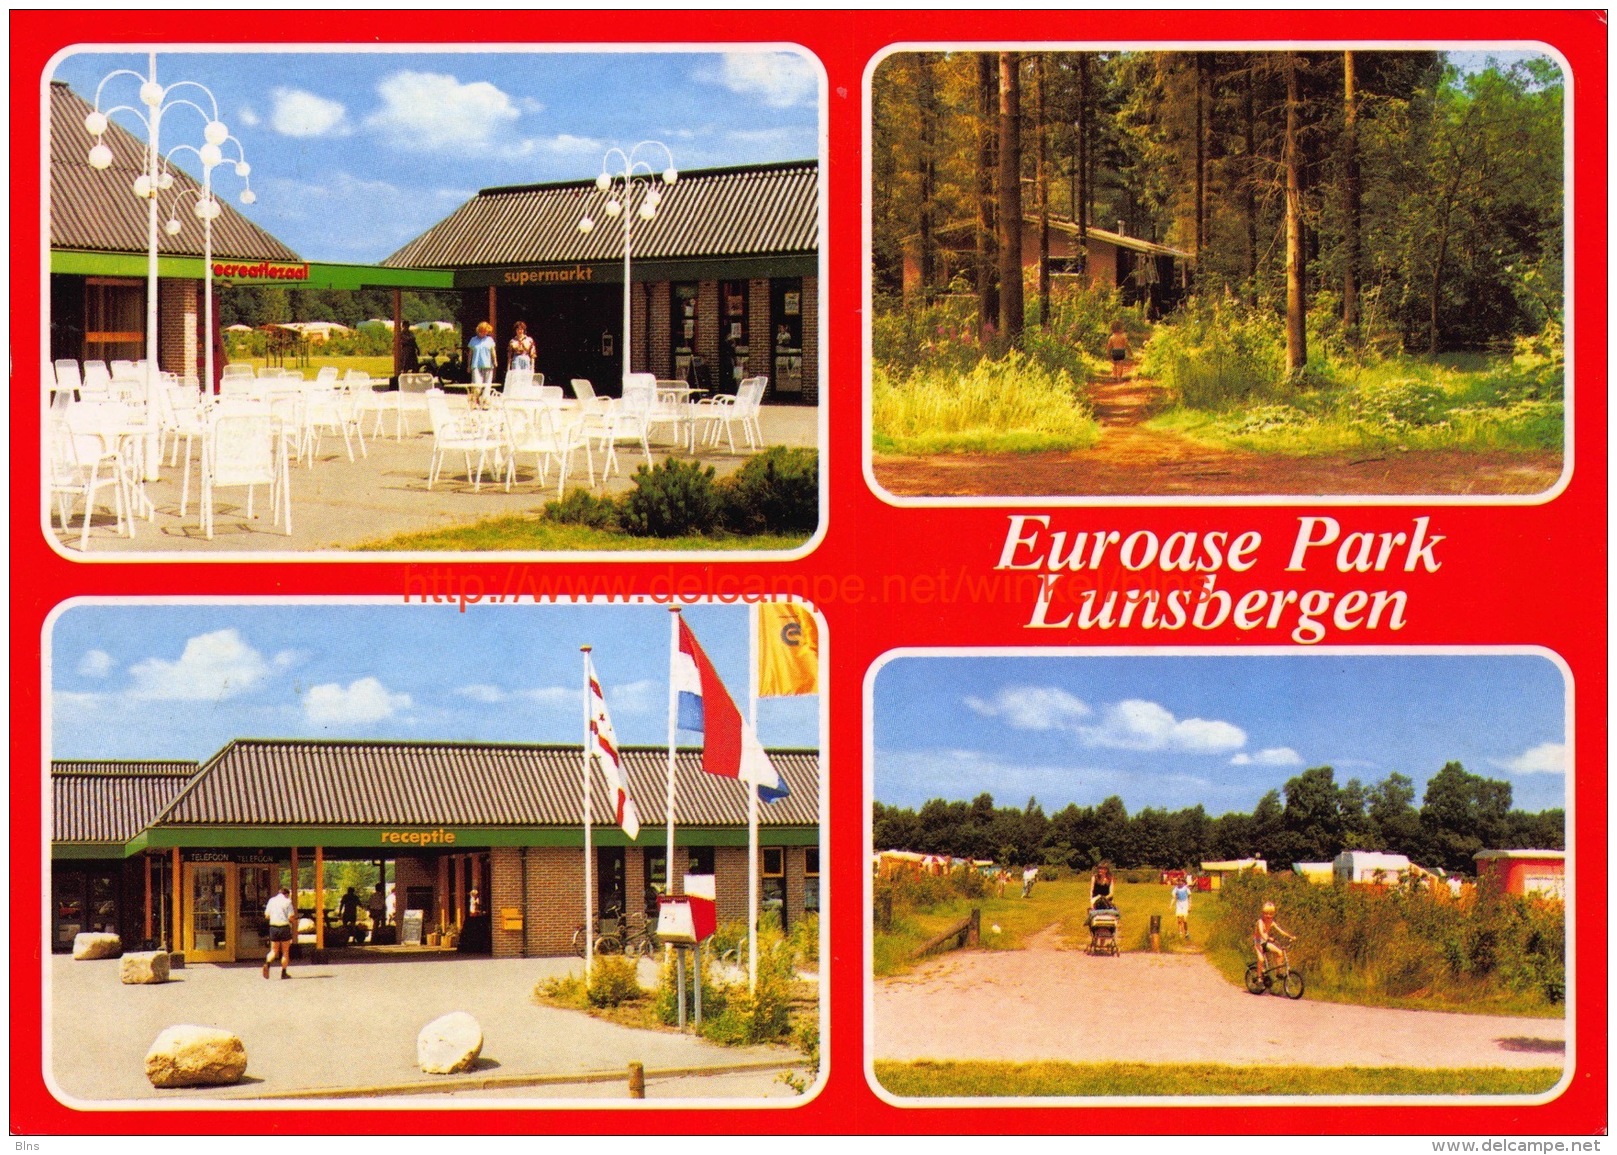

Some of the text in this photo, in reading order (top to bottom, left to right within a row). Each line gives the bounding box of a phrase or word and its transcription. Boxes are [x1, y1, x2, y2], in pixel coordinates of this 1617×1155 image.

[504, 264, 592, 286] supermarkt
[993, 514, 1447, 573] Euroase Park
[1023, 573, 1408, 645] Lunsbergen
[381, 827, 456, 847] receptie
[191, 853, 229, 862] TELEFOON
